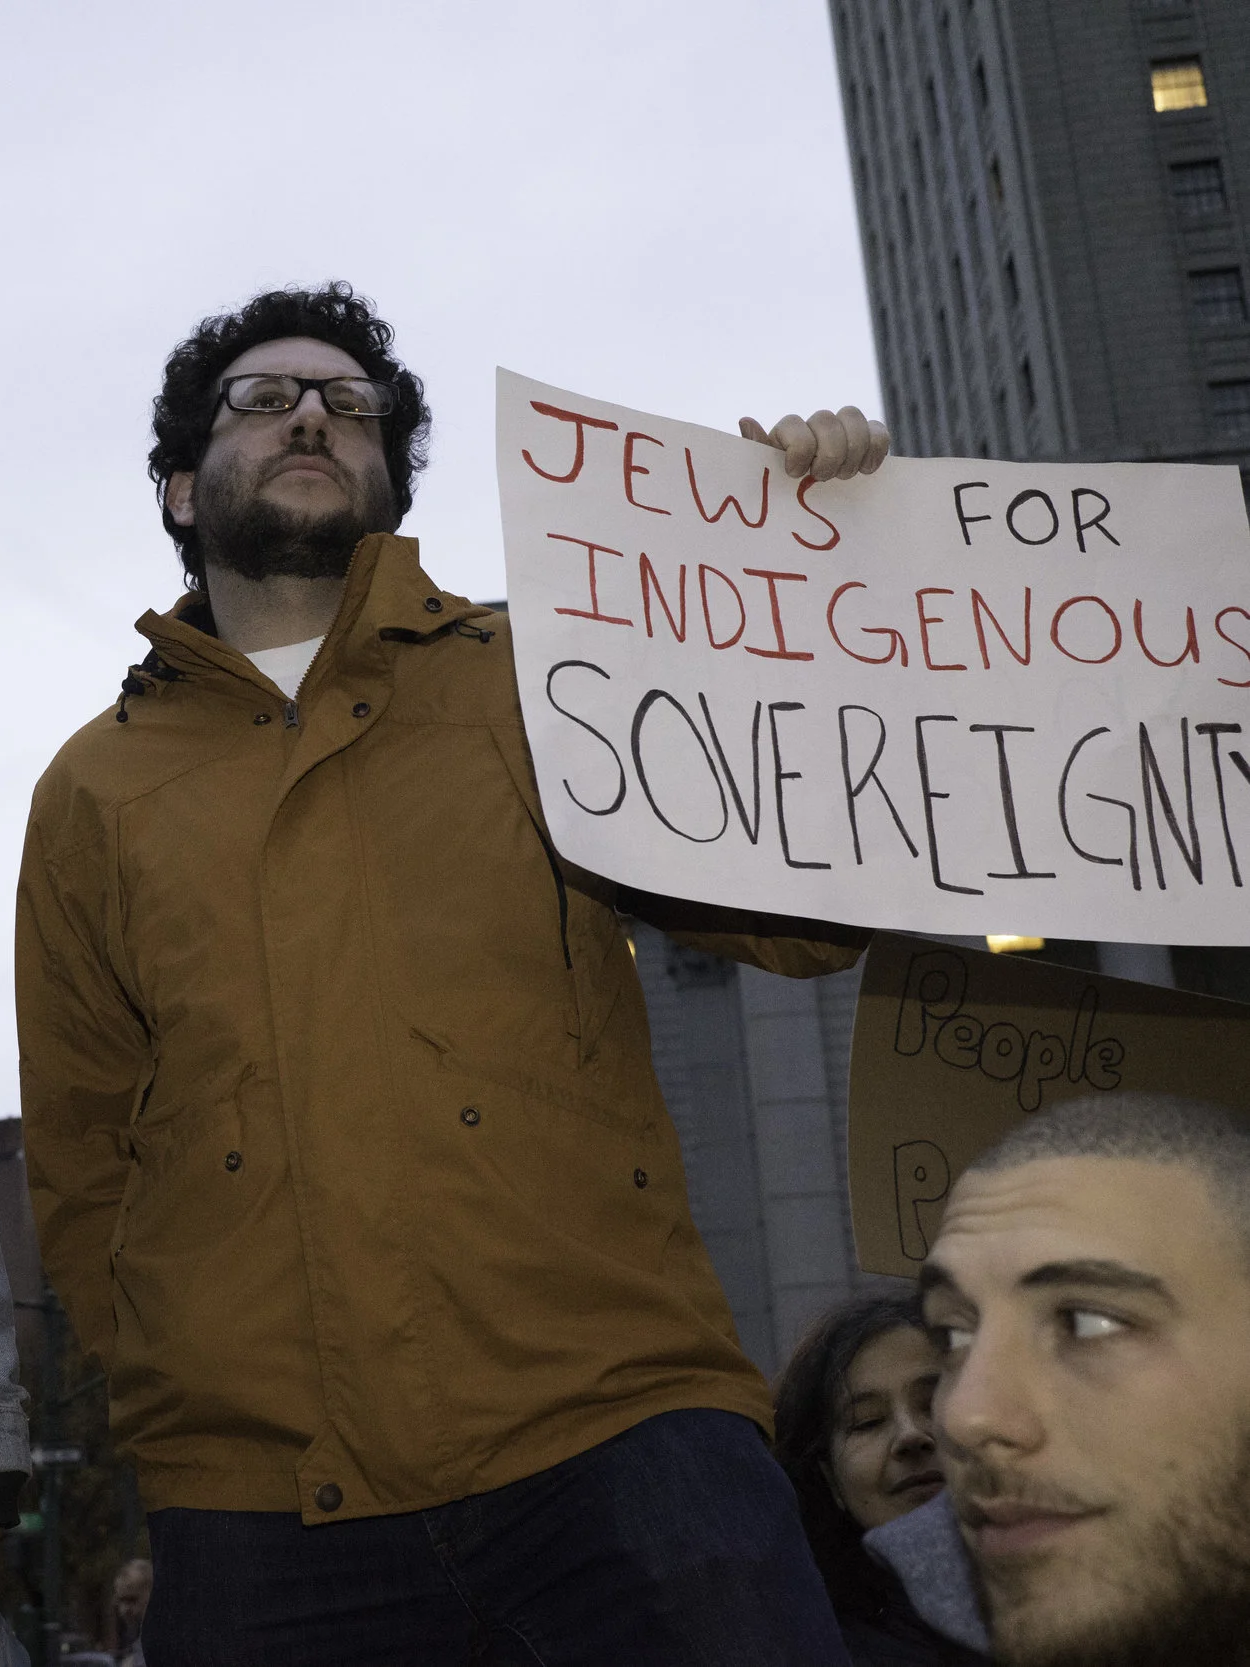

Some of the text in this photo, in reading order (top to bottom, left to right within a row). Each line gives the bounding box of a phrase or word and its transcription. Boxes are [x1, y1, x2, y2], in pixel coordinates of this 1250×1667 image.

[522, 401, 1120, 552] JEWS FOR
[547, 533, 1250, 688] INDIGENOUS
[894, 950, 1125, 1112] People
